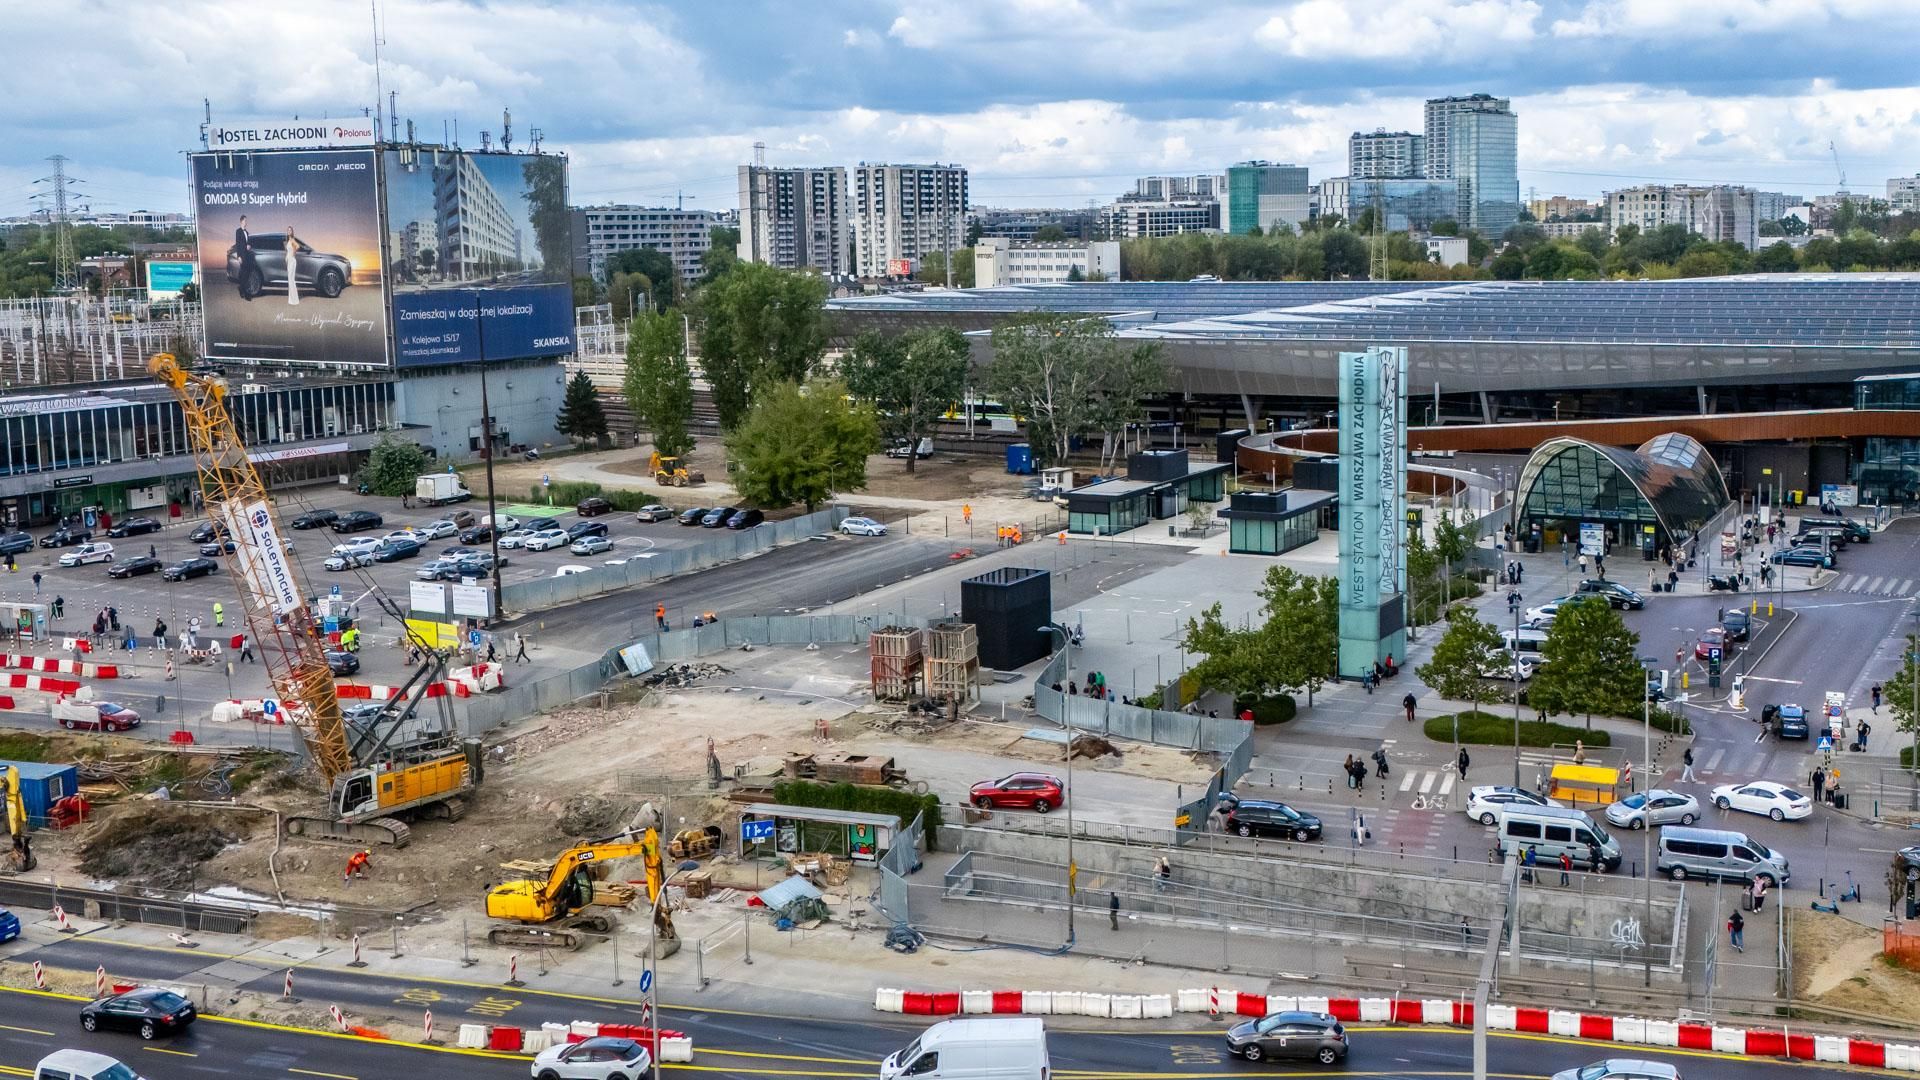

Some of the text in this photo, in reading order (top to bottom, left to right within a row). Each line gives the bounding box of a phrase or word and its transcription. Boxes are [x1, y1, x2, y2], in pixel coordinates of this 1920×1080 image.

[211, 127, 327, 145] HOSTEL ZACHODNI
[343, 128, 372, 138] Polonus
[204, 191, 307, 209] OMODA 9 Super Hybrid
[400, 307, 447, 321] Zamieszkaj
[448, 310, 456, 318] w
[497, 303, 533, 316] lokalizacji
[412, 334, 441, 346] Kolejowa
[443, 333, 460, 343] 15/17
[533, 336, 570, 348] SKANSKA
[1353, 356, 1365, 604] WEST STATION WARSZAWA ZACHODNIA
[1711, 649, 1719, 658] P
